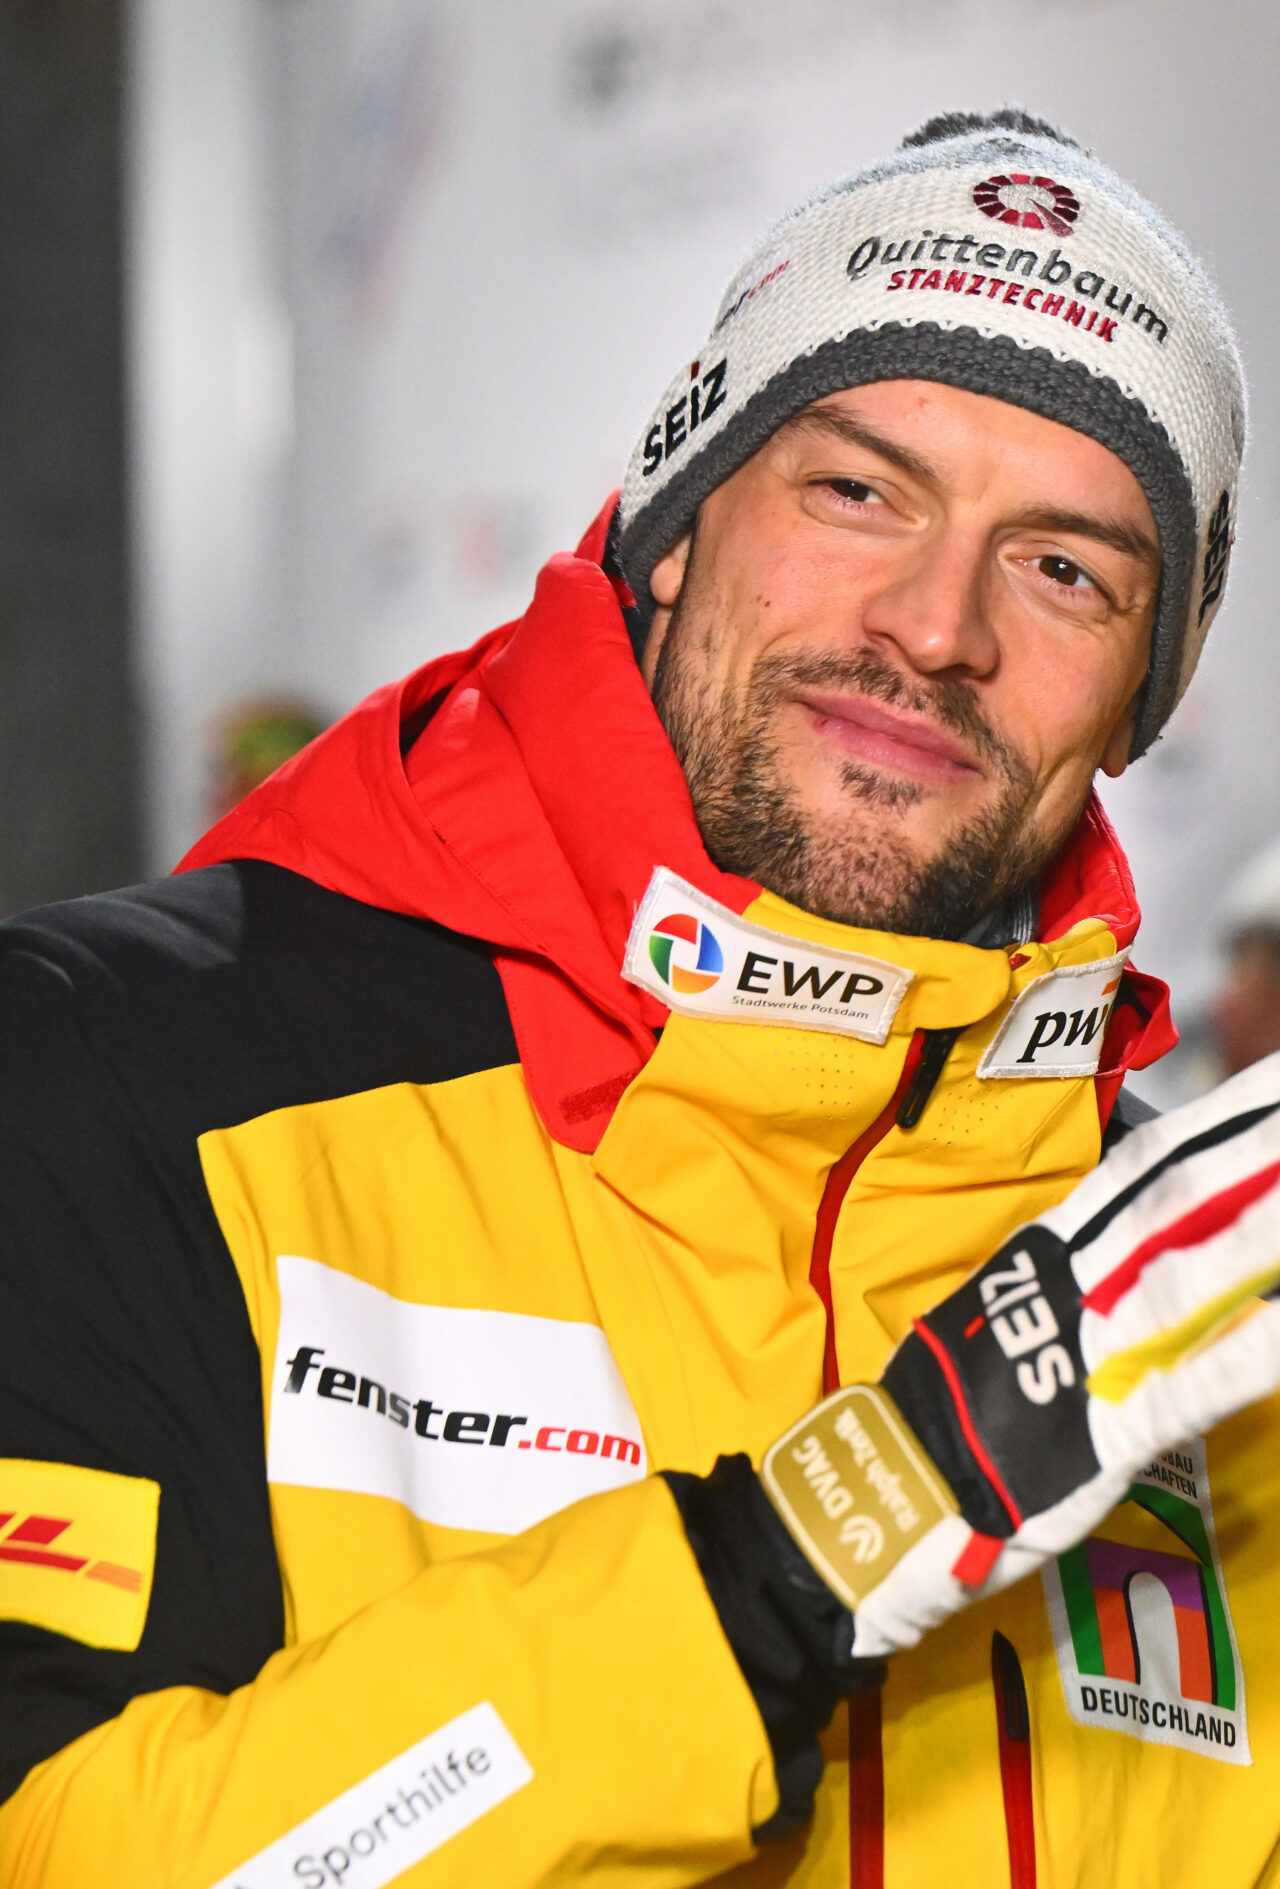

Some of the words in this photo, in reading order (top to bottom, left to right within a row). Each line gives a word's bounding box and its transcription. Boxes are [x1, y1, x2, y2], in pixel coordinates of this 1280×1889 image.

[846, 229, 1171, 345] Quittenbaum
[886, 269, 1119, 343] STANZTECHNIK
[732, 995, 807, 1011] Stadtwerke
[811, 1003, 869, 1020] Potsdam
[736, 951, 884, 1005] EWP
[283, 1346, 642, 1467] fenster.com
[791, 1436, 855, 1521] DVAG
[1080, 1685, 1236, 1748] DEUTSCHLAND
[293, 1745, 492, 1889] Sporthilfe
